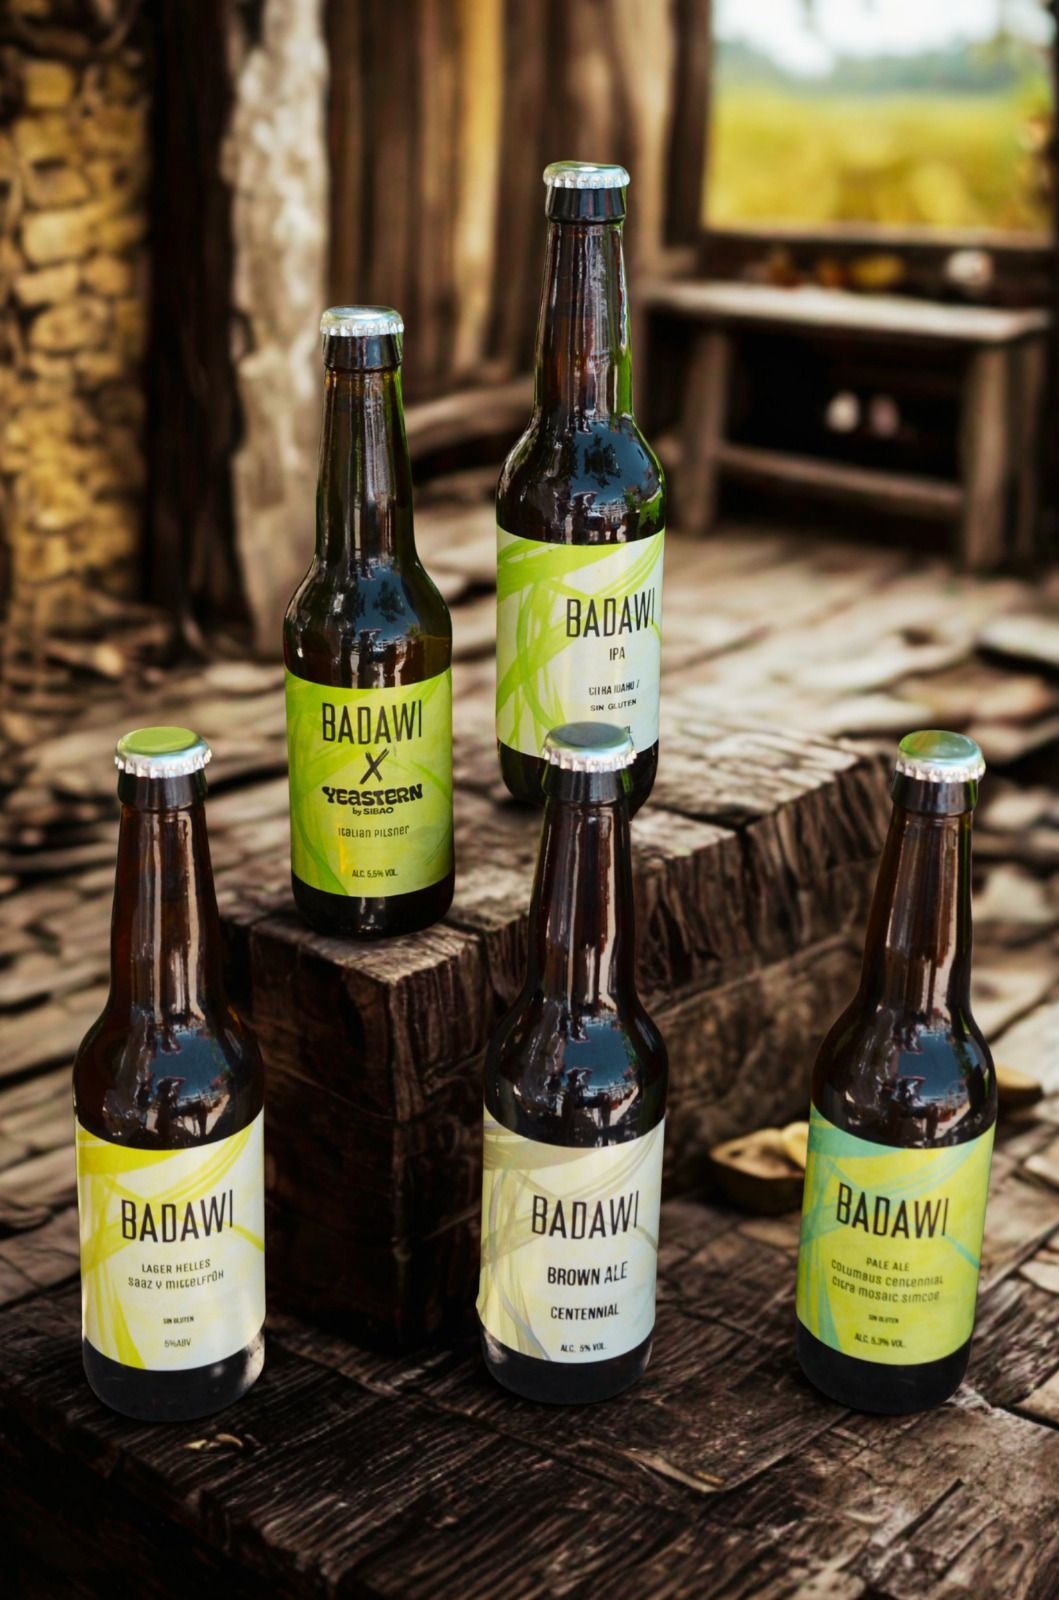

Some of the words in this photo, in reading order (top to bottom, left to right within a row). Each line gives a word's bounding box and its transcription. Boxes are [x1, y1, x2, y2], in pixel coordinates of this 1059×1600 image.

[566, 587, 655, 638] BADAWI
[609, 646, 625, 661] IPA
[590, 704, 605, 712] SIN
[607, 698, 637, 710] GLUTEN
[321, 699, 422, 745] BADAWI
[360, 748, 389, 785] X
[352, 807, 362, 816] by
[363, 806, 394, 815] SIBAO
[121, 1188, 233, 1243] BADAWI
[531, 1190, 639, 1240] BADAWI
[836, 1182, 949, 1239] BADAWI
[142, 1263, 172, 1274] LAGER
[176, 1258, 211, 1273] HELLES
[547, 1266, 601, 1286] BROWN
[604, 1260, 628, 1284] ALE
[866, 1257, 890, 1270] PALE
[892, 1261, 910, 1272] ALE
[550, 1303, 619, 1321] CENTENNIAL
[579, 1344, 591, 1352] 5%
